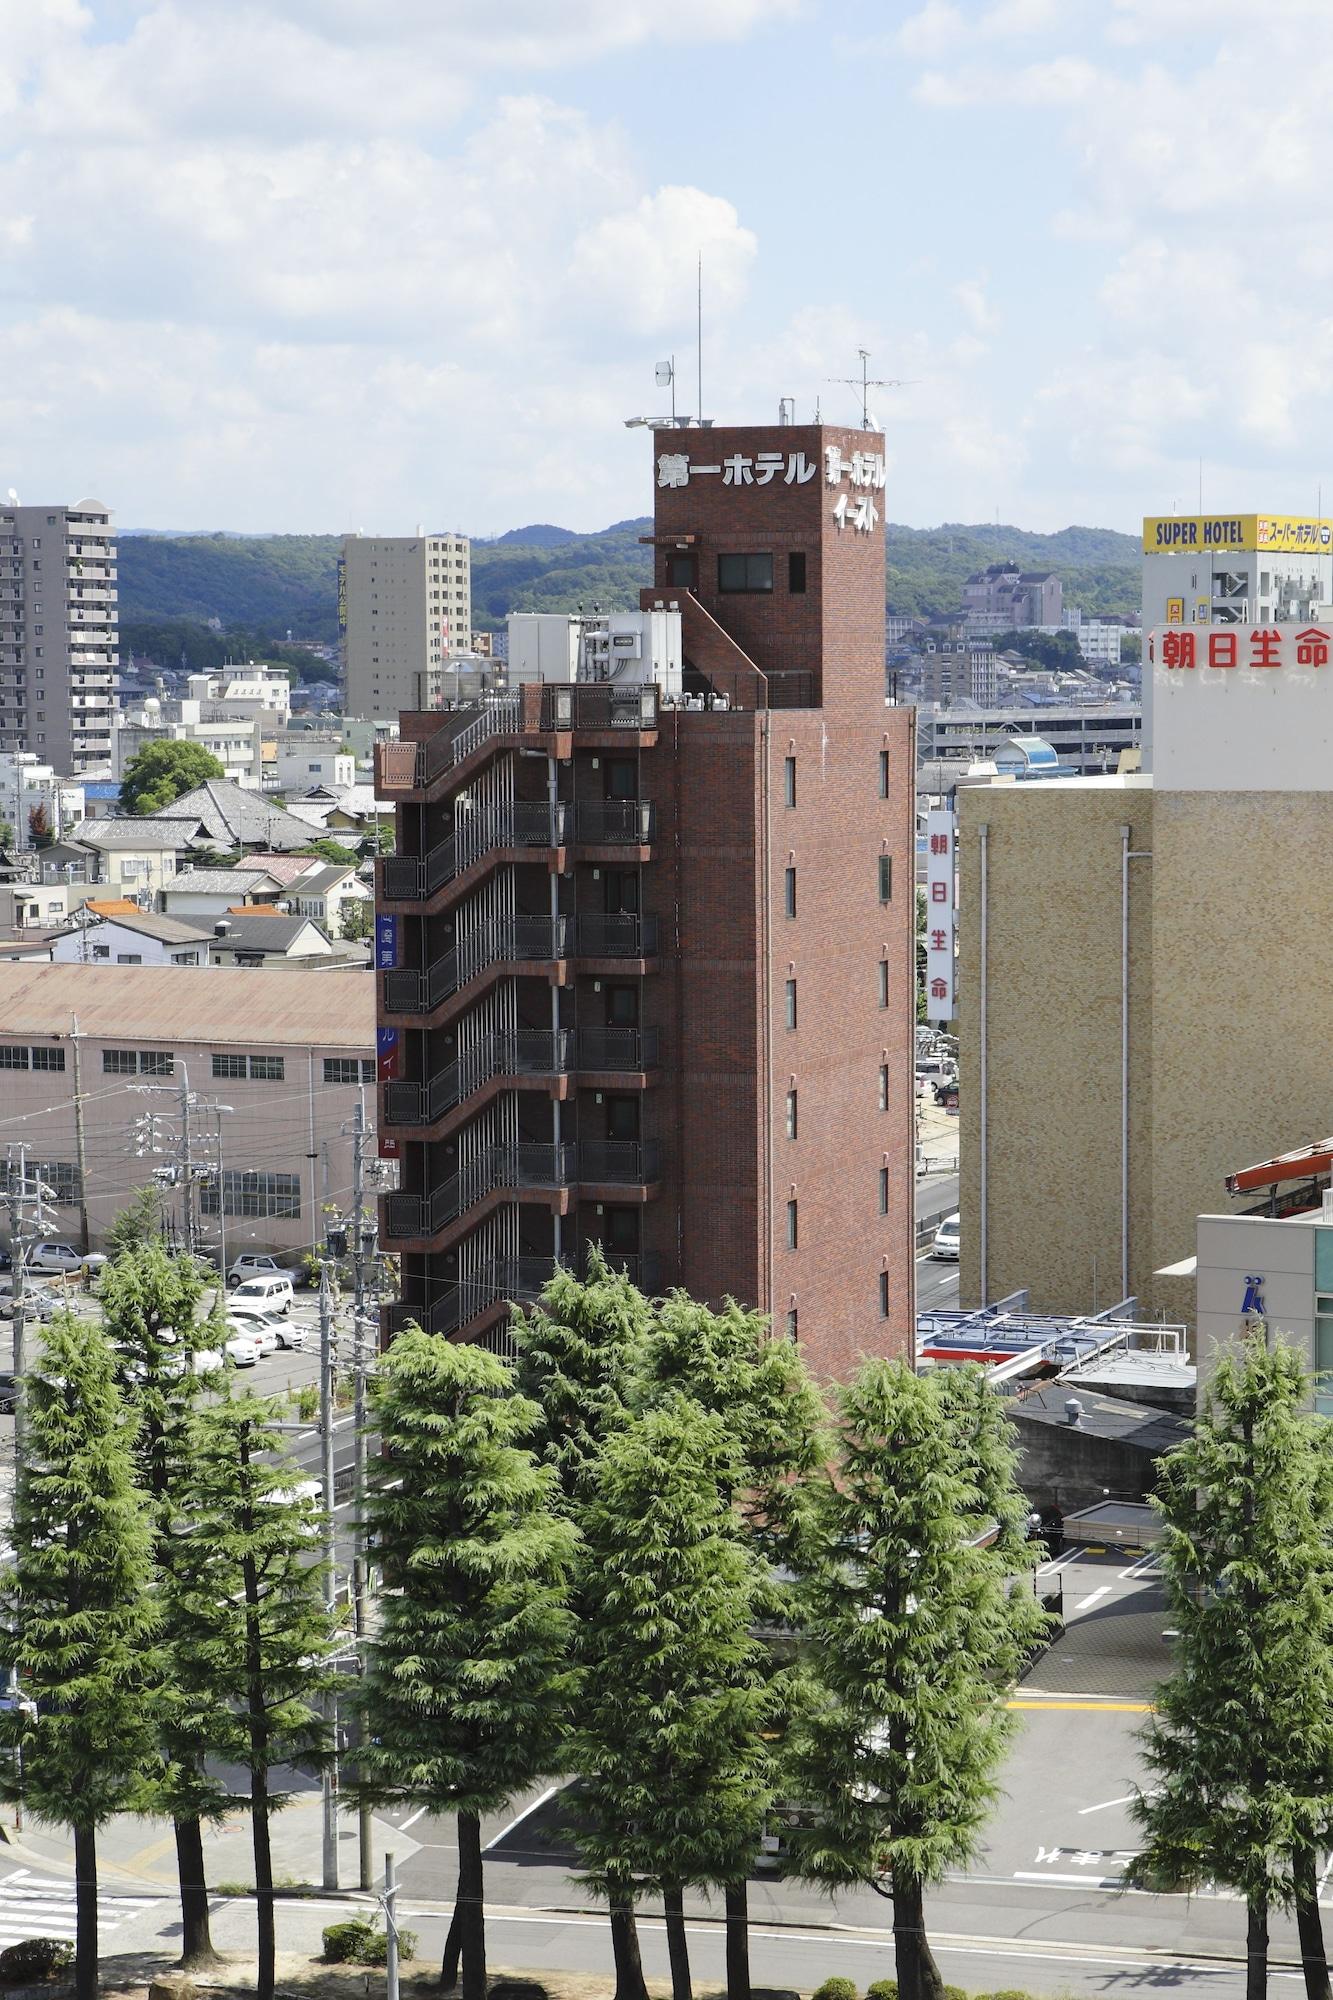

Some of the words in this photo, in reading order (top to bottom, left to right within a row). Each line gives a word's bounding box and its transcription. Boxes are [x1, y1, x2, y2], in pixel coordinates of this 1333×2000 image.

[657, 452, 816, 488] 第一ホテル
[825, 446, 886, 488] 第一ホテル
[833, 494, 879, 531] イースト
[1156, 521, 1197, 545] SUPER
[1203, 520, 1244, 544] HOTEL
[1269, 522, 1319, 545] スーパーホテル
[1162, 628, 1331, 668] 朝日生命
[930, 833, 948, 1000] 朝日生命
